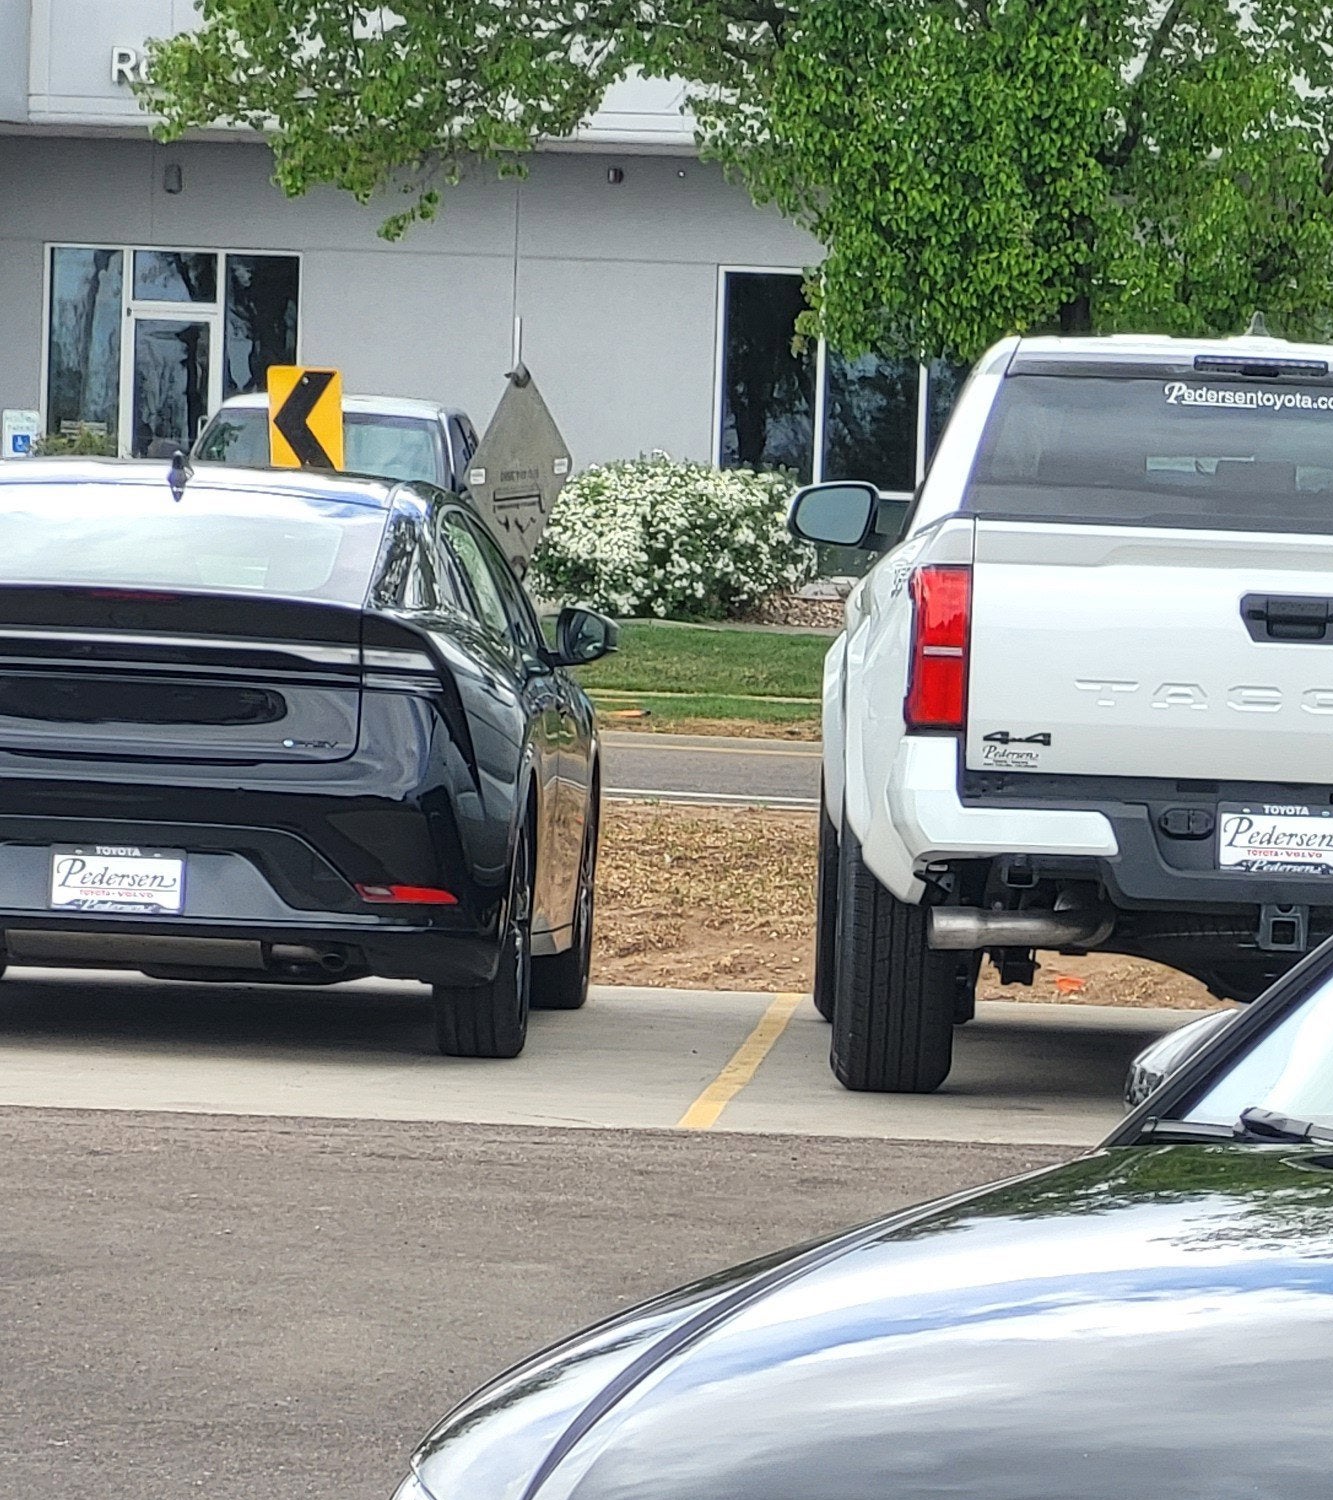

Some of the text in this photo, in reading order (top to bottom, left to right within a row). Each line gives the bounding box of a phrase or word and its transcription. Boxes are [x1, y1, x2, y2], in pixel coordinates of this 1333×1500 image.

[1263, 805, 1310, 816] TOYOTA
[95, 845, 142, 857] TOYOTA
[1247, 849, 1323, 858] TOYOTA VOLVO
[56, 857, 178, 888] Pedersen
